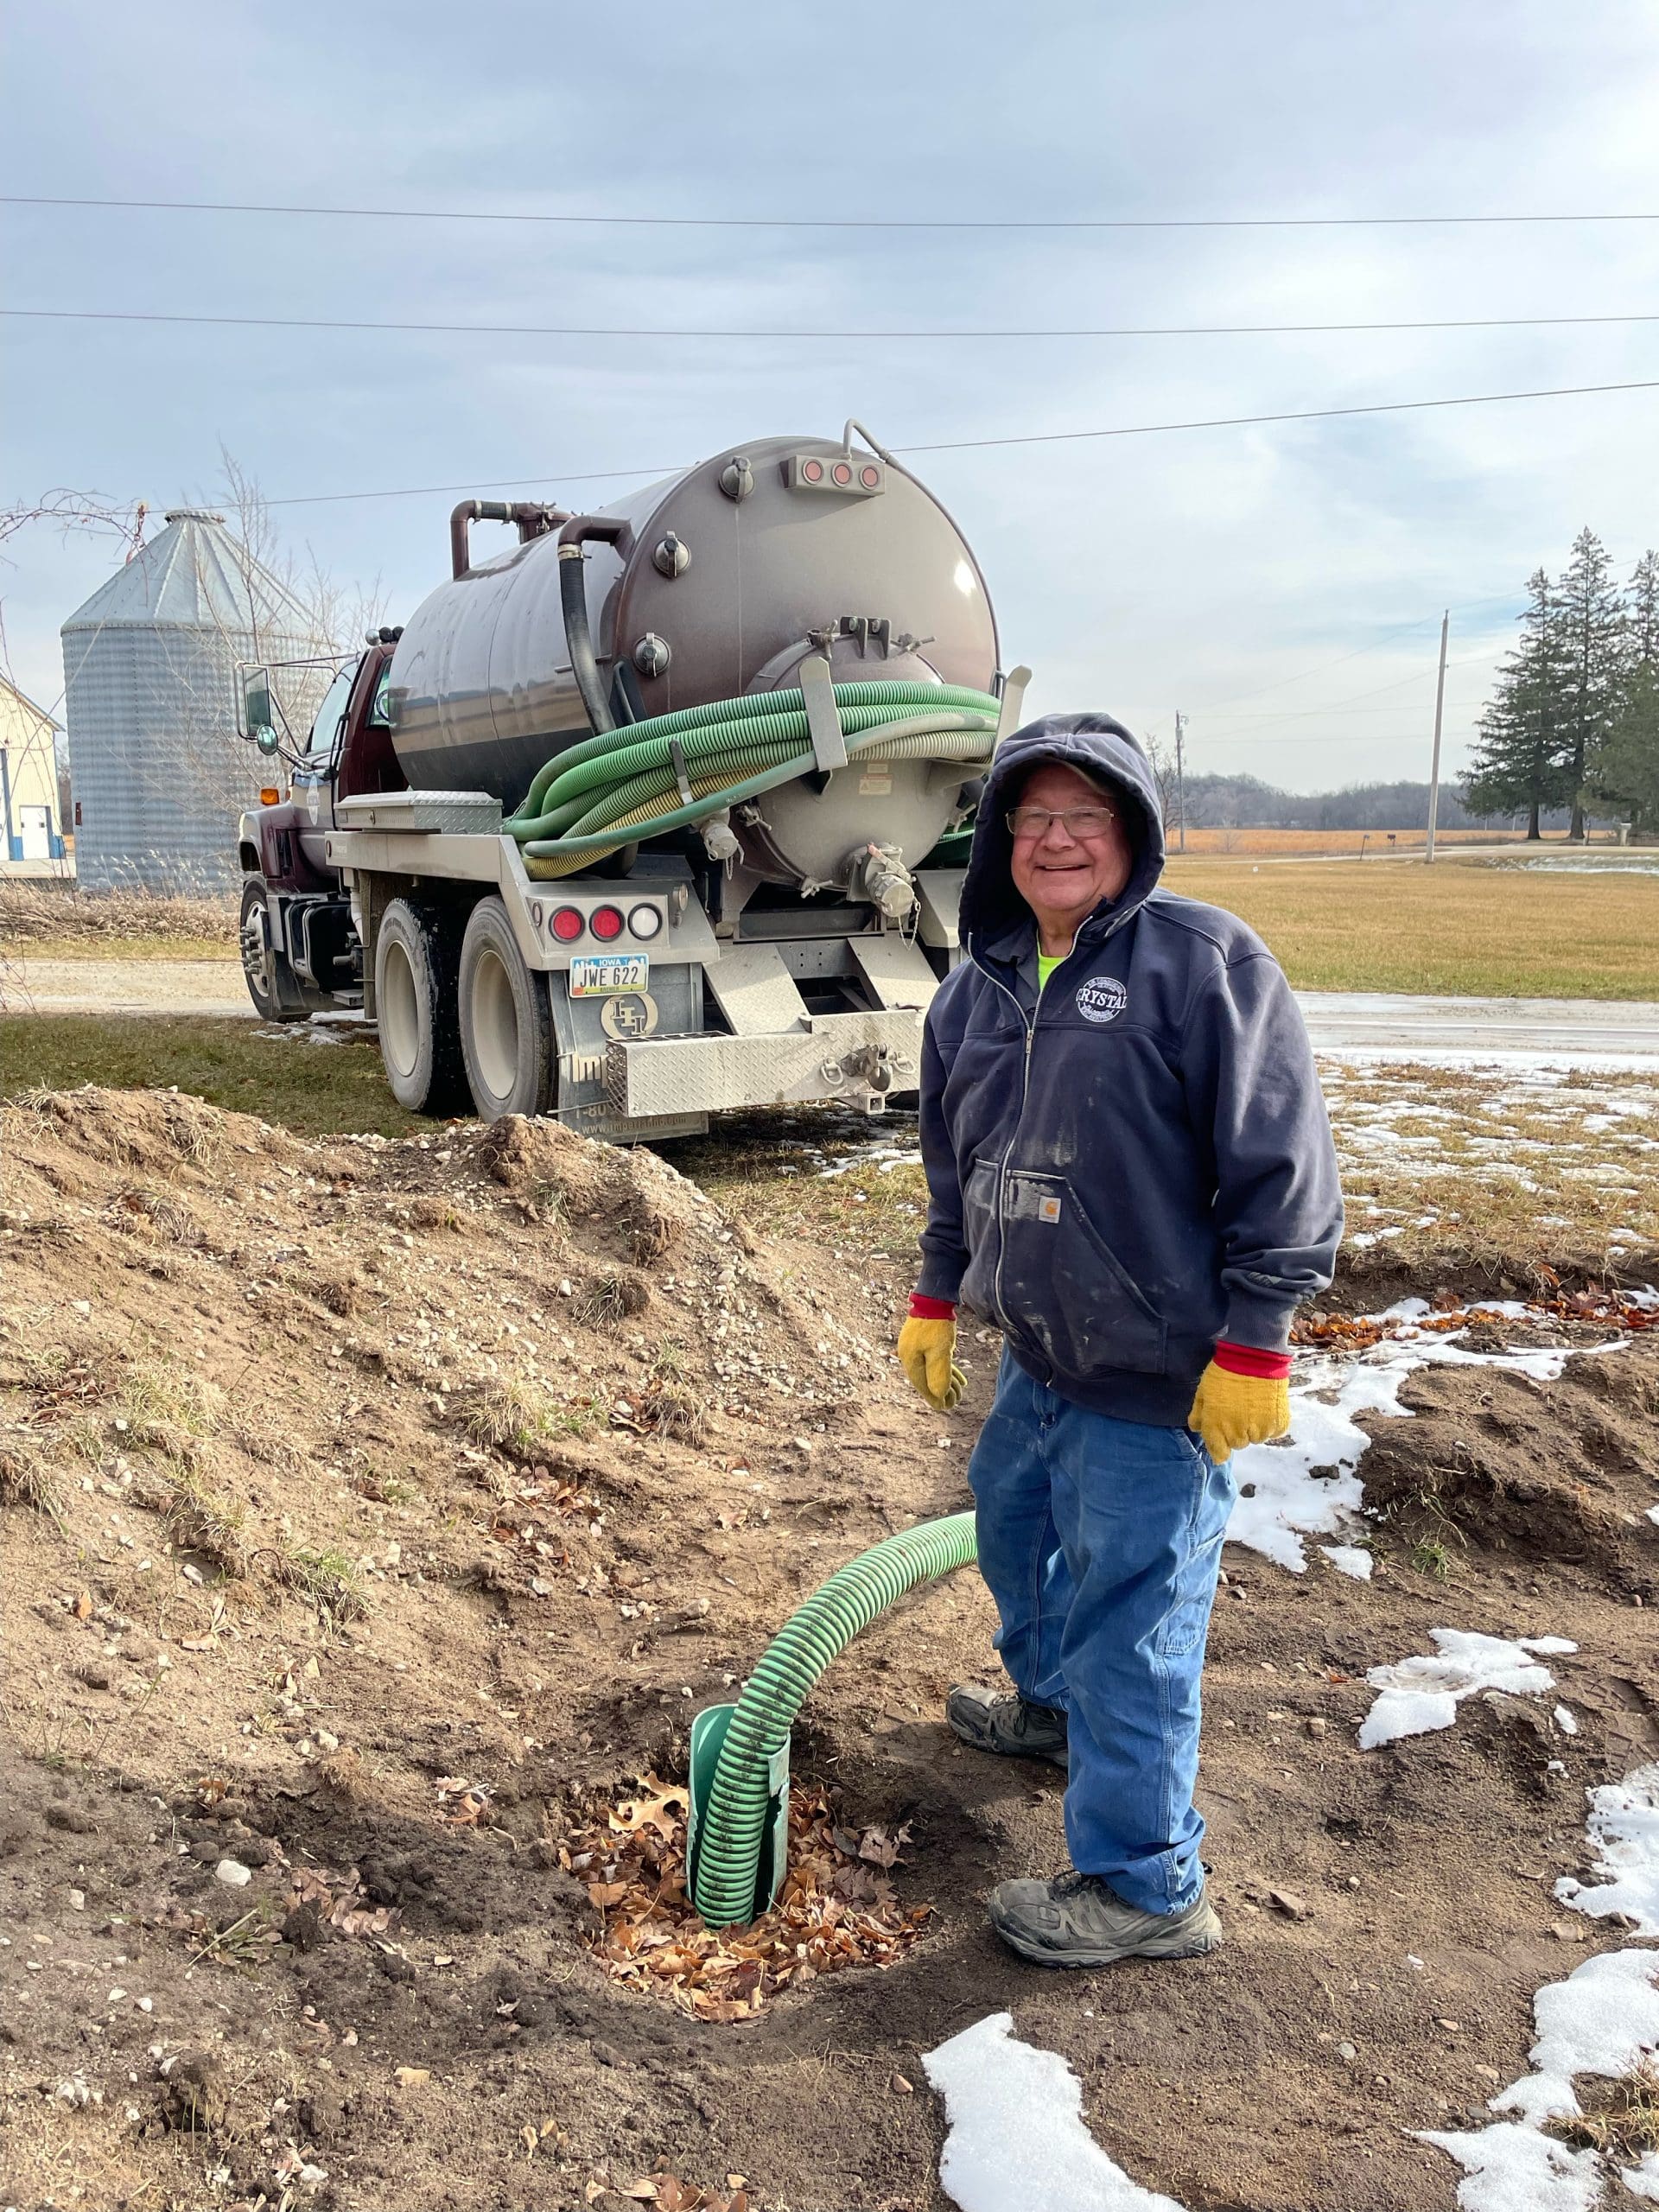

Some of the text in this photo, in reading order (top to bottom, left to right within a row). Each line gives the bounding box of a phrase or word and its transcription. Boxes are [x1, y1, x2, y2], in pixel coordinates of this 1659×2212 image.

[599, 958, 621, 967] IOWA
[580, 966, 639, 988] JWE 622
